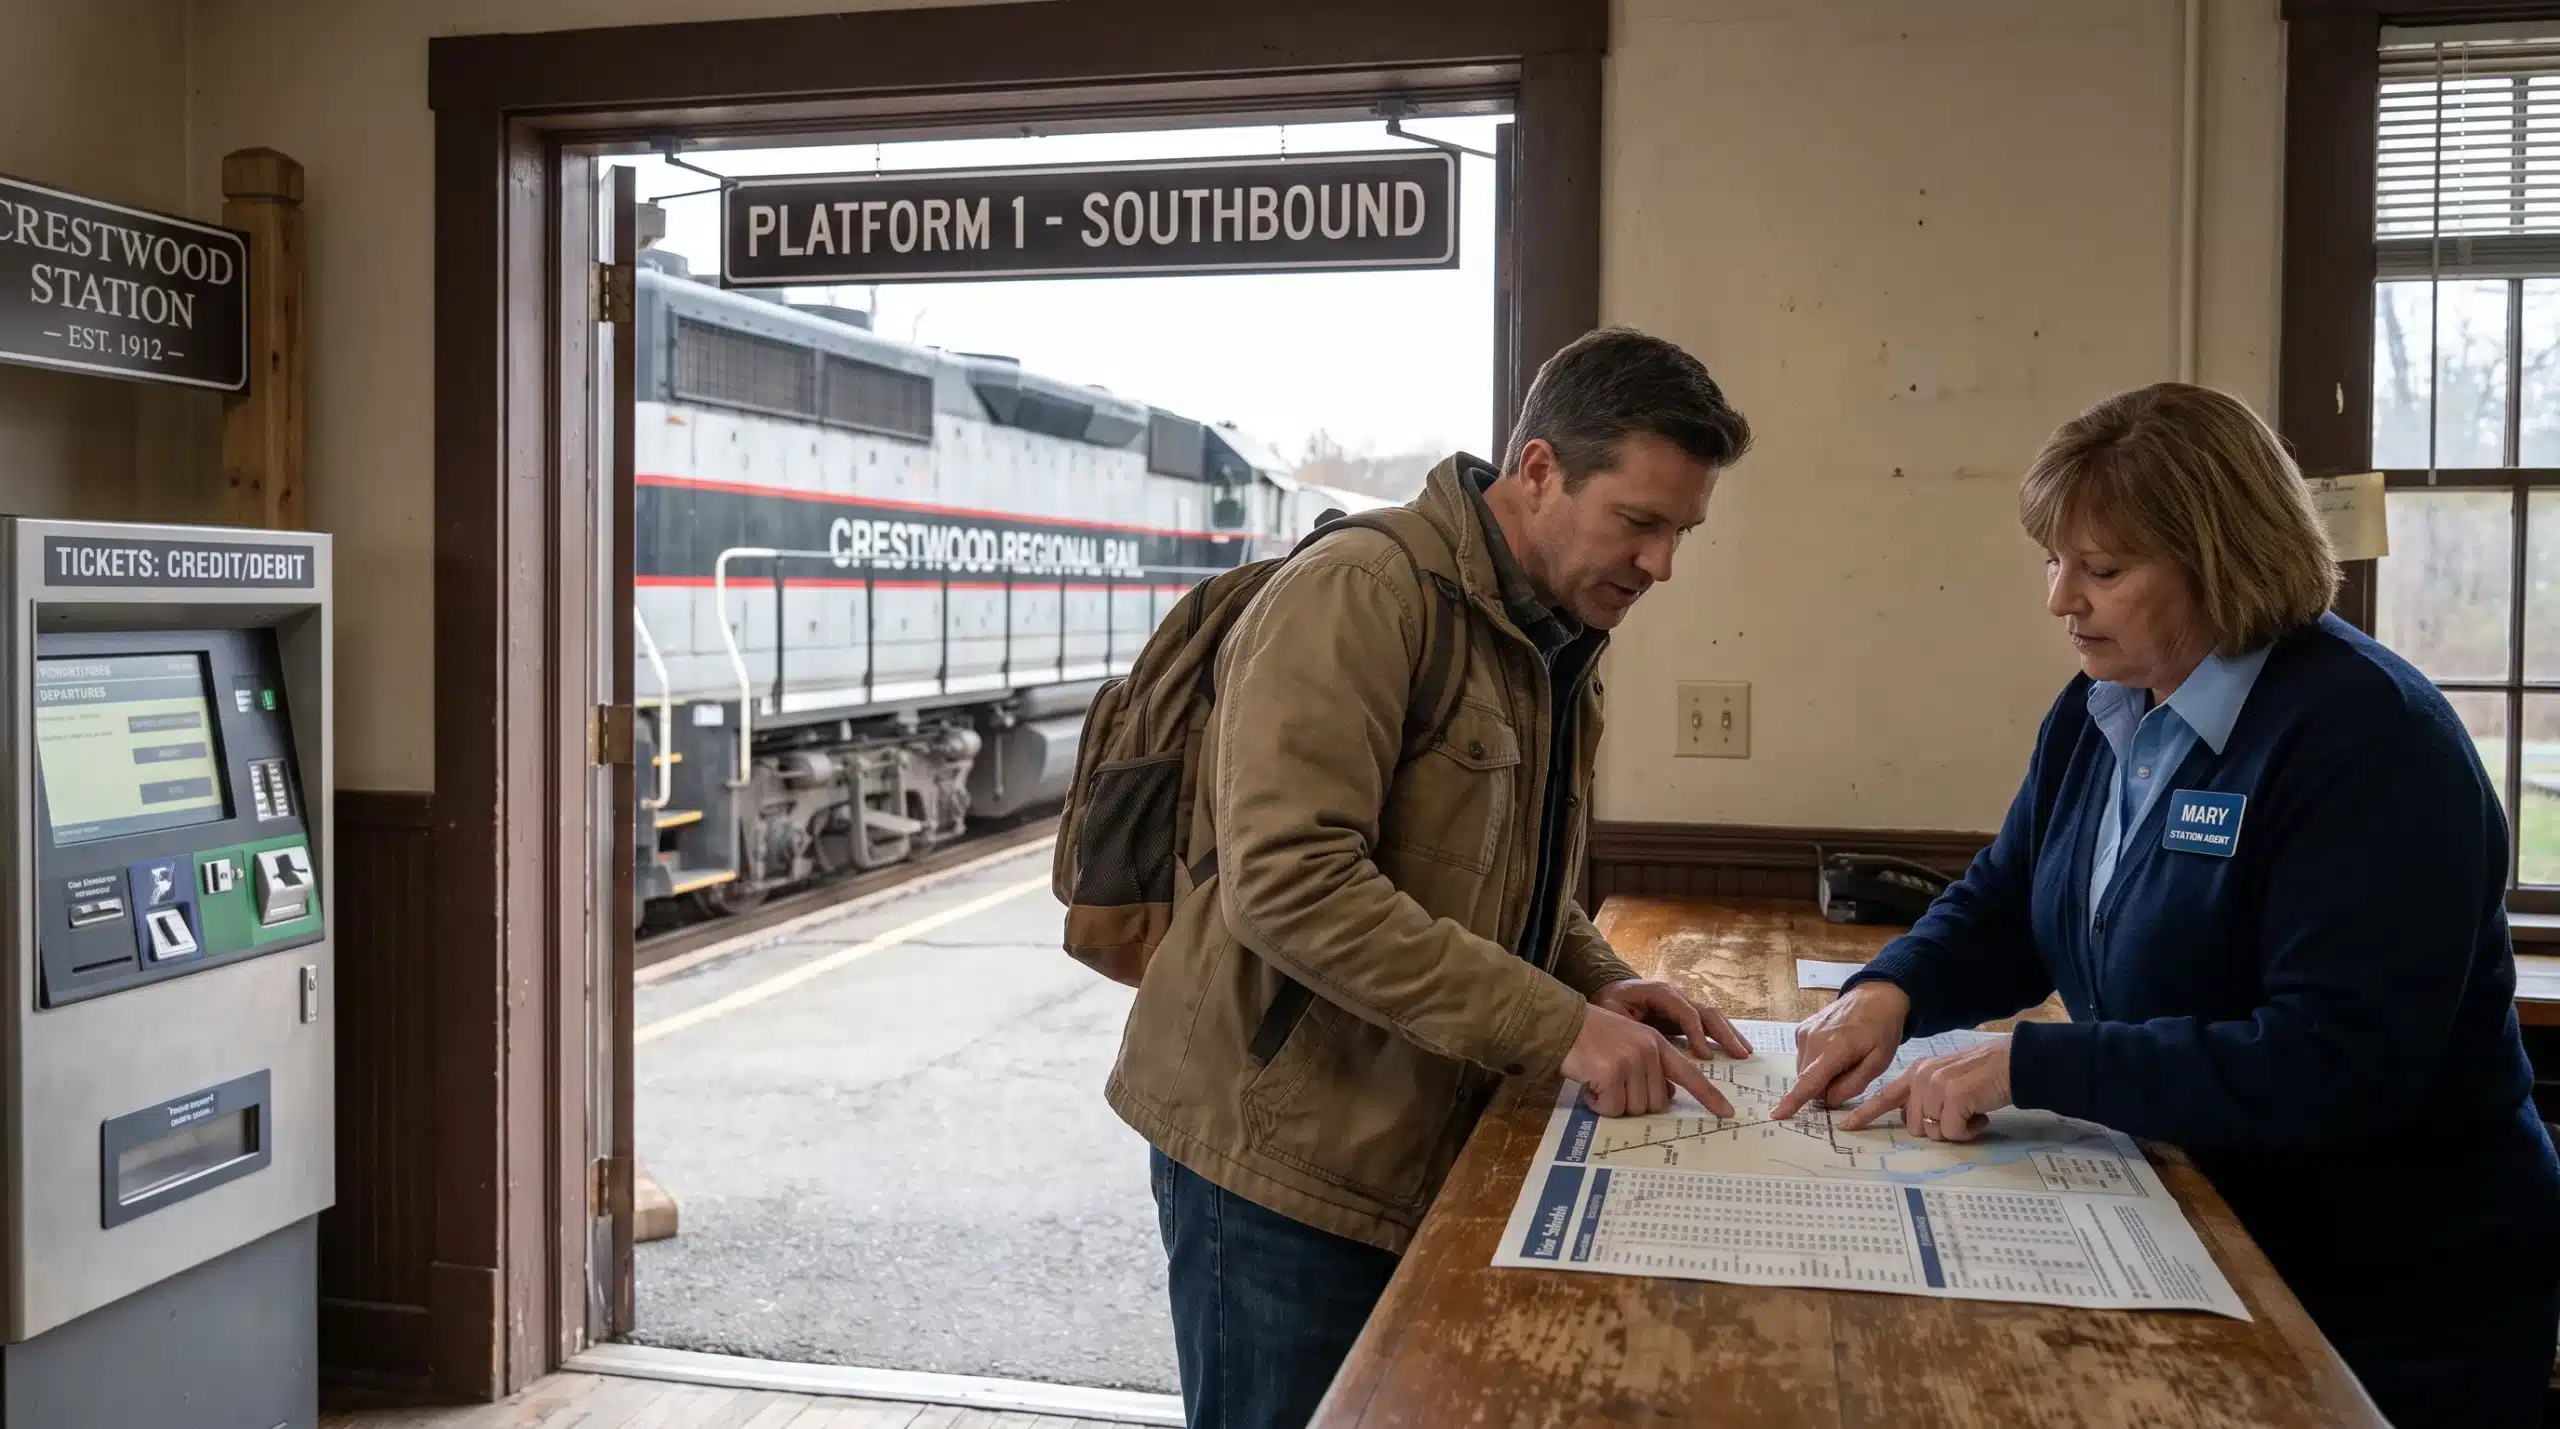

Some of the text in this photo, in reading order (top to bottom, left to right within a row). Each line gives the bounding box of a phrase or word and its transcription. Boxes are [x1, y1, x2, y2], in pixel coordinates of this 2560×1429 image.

[749, 197, 990, 257] PLATFORM
[1012, 196, 1024, 248] 1
[1081, 181, 1426, 248] SOUTHBOUND
[0, 199, 233, 285] CRESTWOOD
[31, 263, 195, 329] STATION
[68, 325, 112, 353] EST.
[120, 334, 163, 360] 1912
[56, 547, 305, 581] TICKETS: CREDIT/DEBIT
[830, 517, 1145, 578] CRESTWOOD REGIONAL RAIL
[40, 687, 106, 701] DEPARTURES
[2181, 804, 2229, 825] MARY
[2169, 830, 2203, 841] STATION
